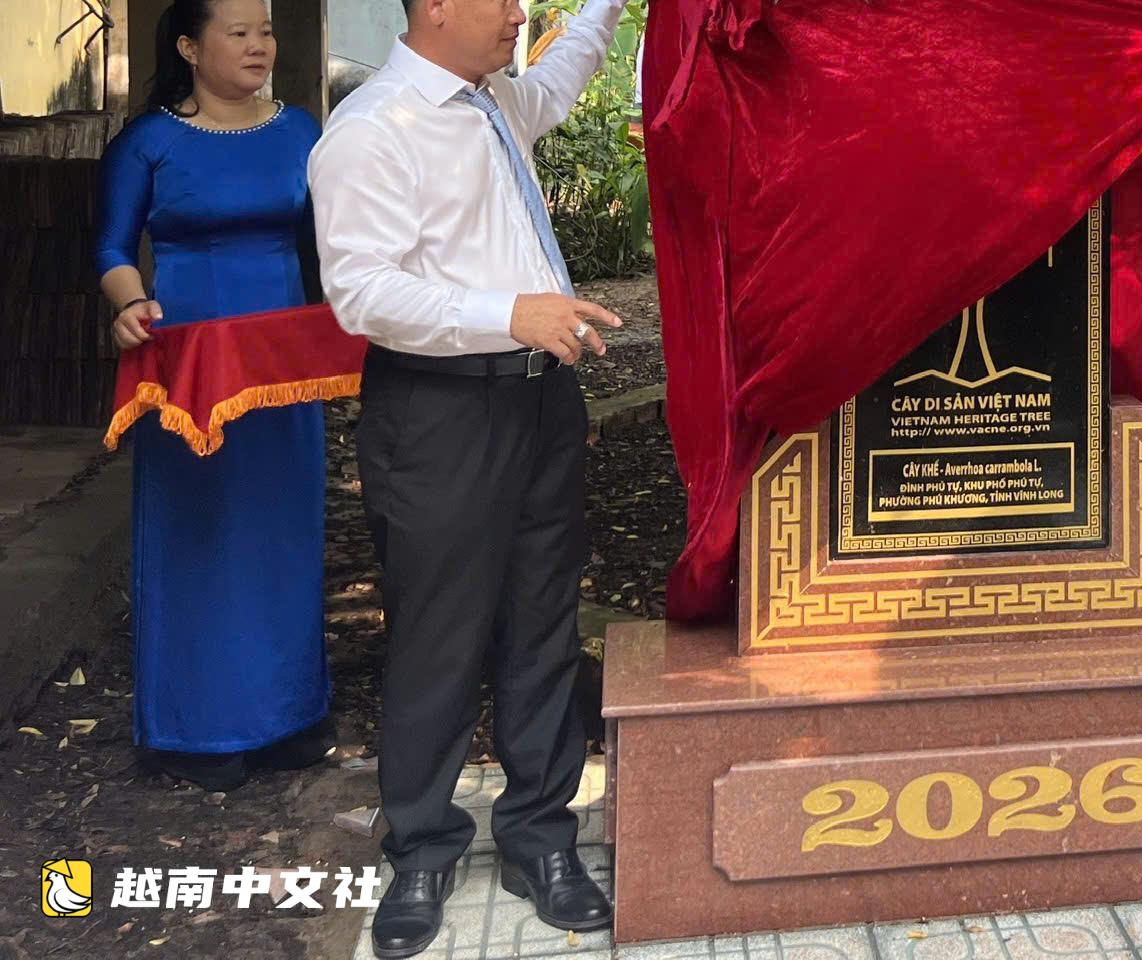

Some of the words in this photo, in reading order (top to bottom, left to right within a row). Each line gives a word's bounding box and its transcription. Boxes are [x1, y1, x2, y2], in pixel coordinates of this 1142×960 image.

[891, 395, 921, 412] CÂY
[924, 397, 940, 411] DI
[943, 392, 975, 411] SẢN
[978, 392, 1012, 412] VIỆT
[1015, 393, 1051, 408] NAM
[891, 415, 951, 427] VIETNAM
[954, 413, 1017, 425] HERITAGE
[1020, 411, 1051, 422] TREE
[891, 427, 931, 438] http://
[934, 423, 1050, 436] www.vacne.org.vn
[903, 461, 920, 478] CÂY
[922, 459, 939, 477] KHẾ
[945, 462, 983, 476] Averrhoa
[985, 459, 1033, 474] carrambola
[1034, 459, 1042, 472] L.
[900, 482, 924, 493] ĐÌNH
[926, 481, 945, 491] PHÚ
[964, 481, 984, 490] KHU
[1008, 477, 1027, 488] PHÚ
[923, 494, 943, 505] PHÚ
[1038, 489, 1064, 500] LONG
